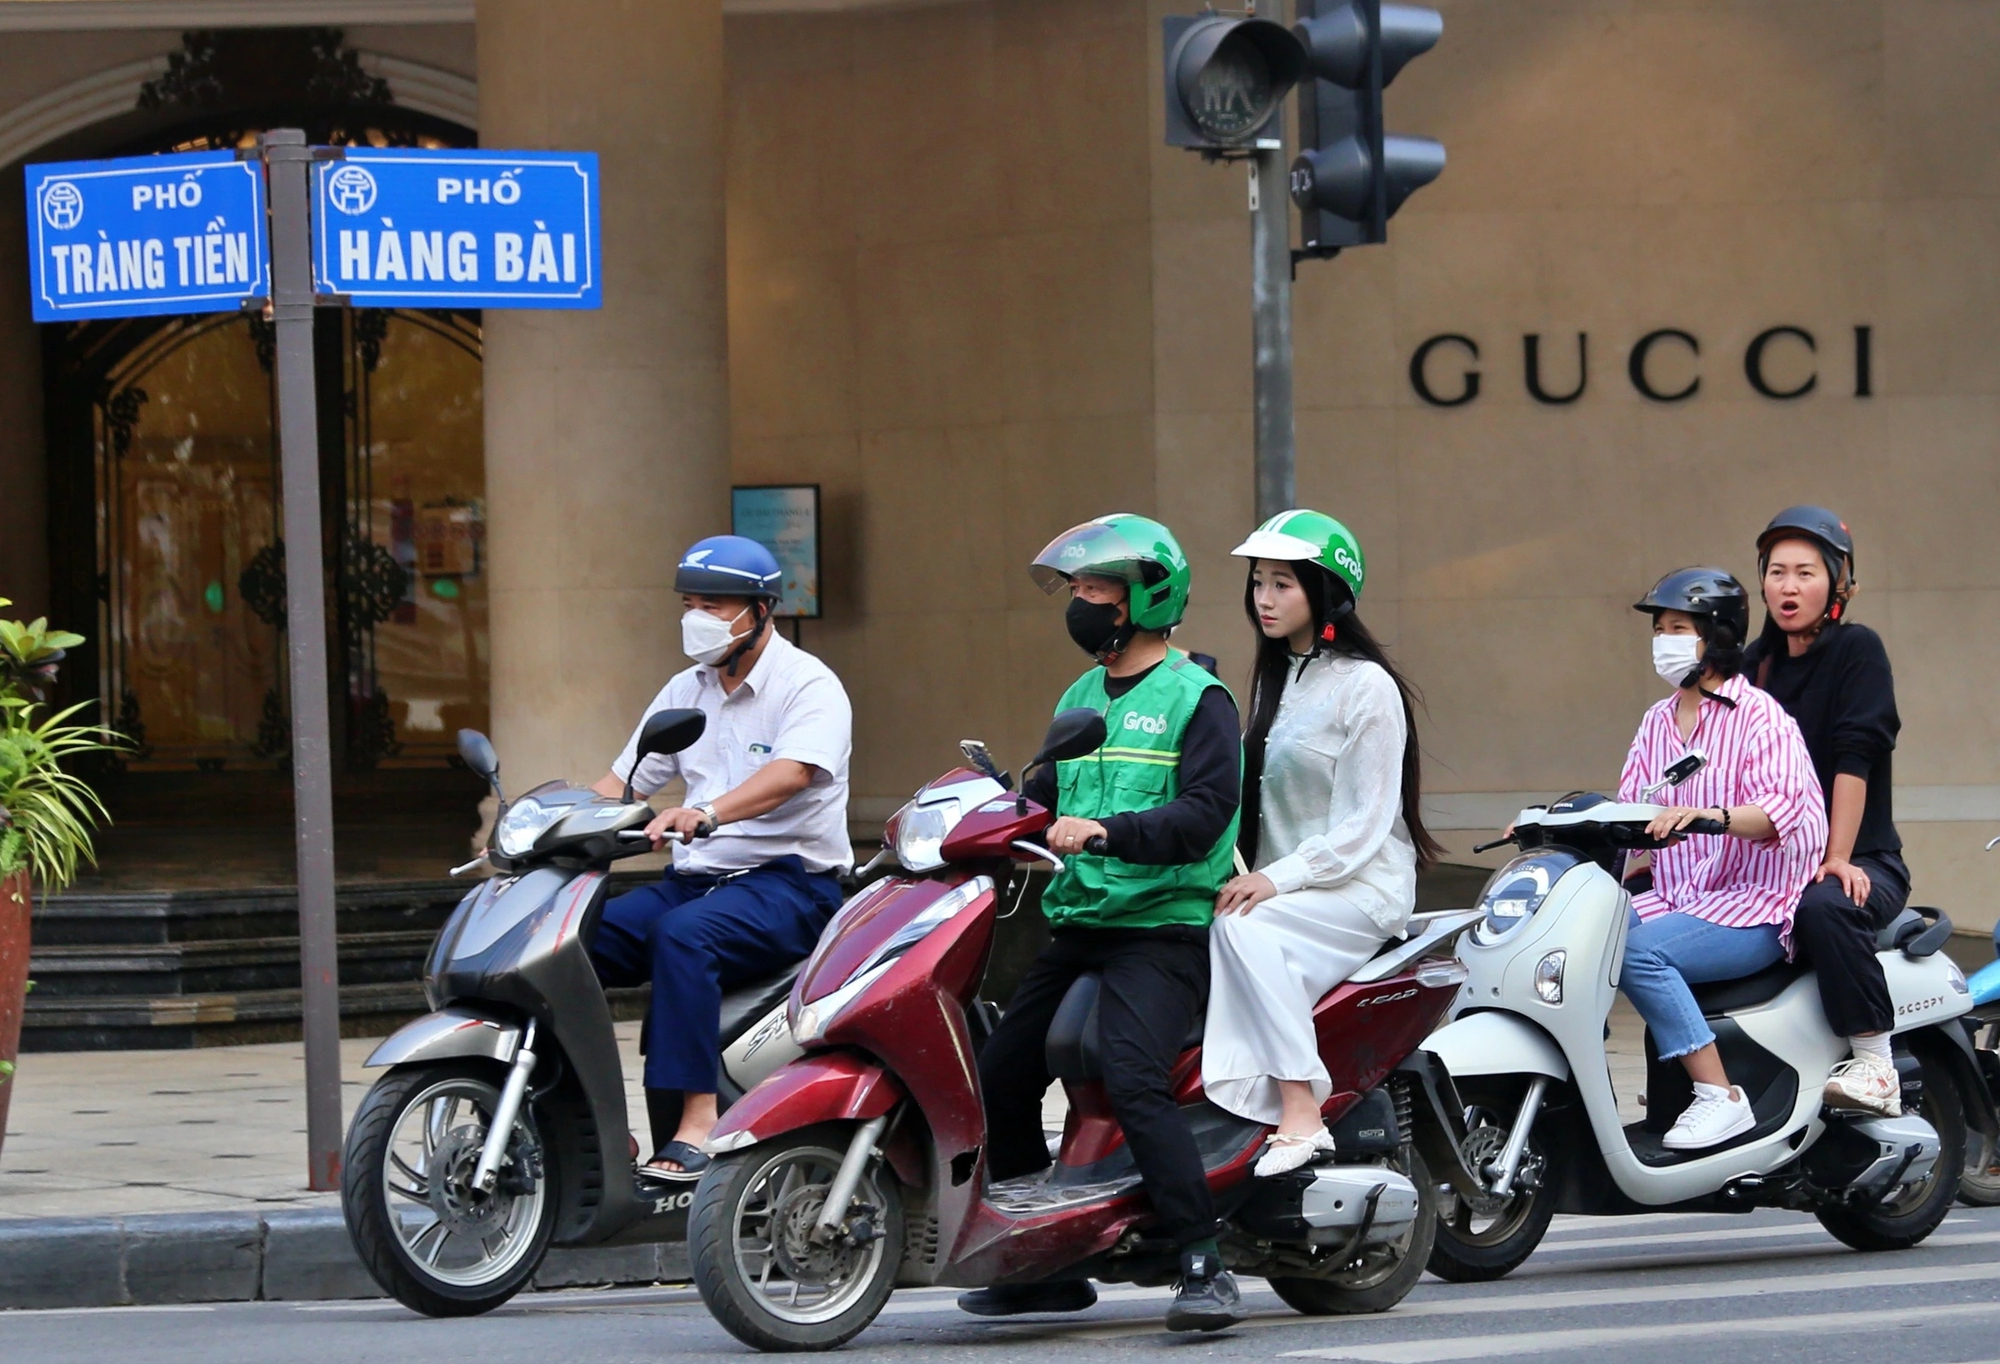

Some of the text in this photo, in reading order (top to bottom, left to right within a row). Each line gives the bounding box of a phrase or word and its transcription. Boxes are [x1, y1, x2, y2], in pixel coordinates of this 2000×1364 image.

[132, 169, 203, 211] PHỐ
[437, 168, 522, 204] PHỐ
[52, 216, 249, 294] TRÀNG TIỀN
[339, 217, 576, 282] HÀNG BÀI
[1408, 324, 1873, 407] GUCCI
[1334, 547, 1363, 582] Grab
[1123, 710, 1167, 735] Grab
[1898, 995, 1945, 1016] SCOOPY
